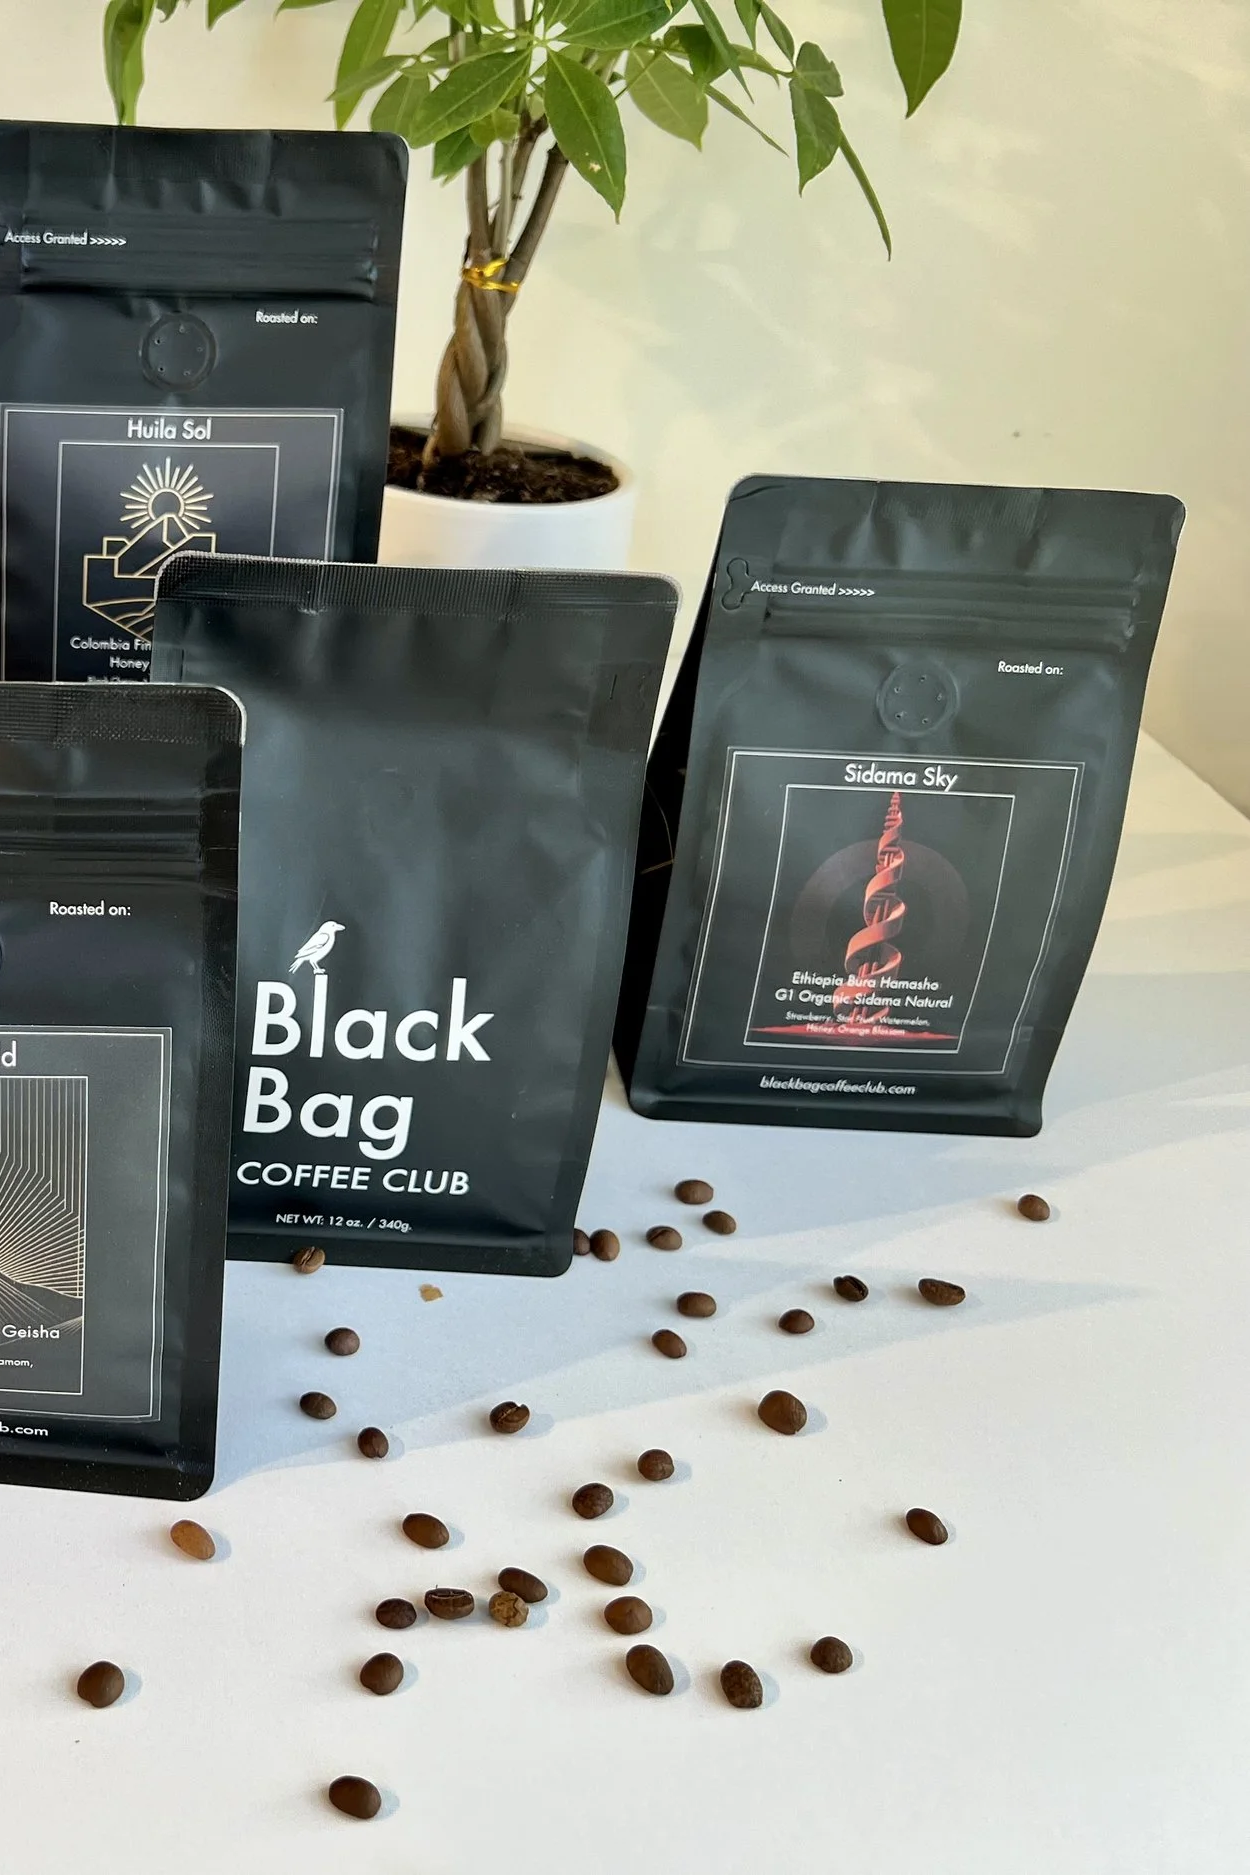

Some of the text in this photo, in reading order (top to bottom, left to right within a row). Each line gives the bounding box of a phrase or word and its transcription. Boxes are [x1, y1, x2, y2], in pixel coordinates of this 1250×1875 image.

[5, 231, 40, 245] Access
[43, 231, 88, 246] Granted
[255, 310, 318, 325] Roasted on:
[127, 418, 211, 441] Huila Sol
[751, 580, 787, 595] Access
[790, 582, 836, 596] Granted
[70, 637, 151, 651] Colombia Fin
[110, 656, 150, 671] Honey
[997, 660, 1063, 677] Roasted on:
[844, 763, 958, 792] Sidama Sky
[50, 900, 132, 917] Roasted on:
[792, 971, 939, 991] Ethiopia Bura Hamasho
[775, 988, 953, 1009] G1 Organic Sidama Natural
[251, 974, 494, 1062] Black
[759, 1075, 915, 1095] blackbagcoffeeclub.com
[243, 1066, 414, 1160] Bag
[236, 1161, 470, 1196] COFFEE CLUB
[275, 1213, 299, 1224] NET
[328, 1216, 343, 1227] 12
[346, 1218, 363, 1228] oz.
[1, 1324, 60, 1339] Geisha
